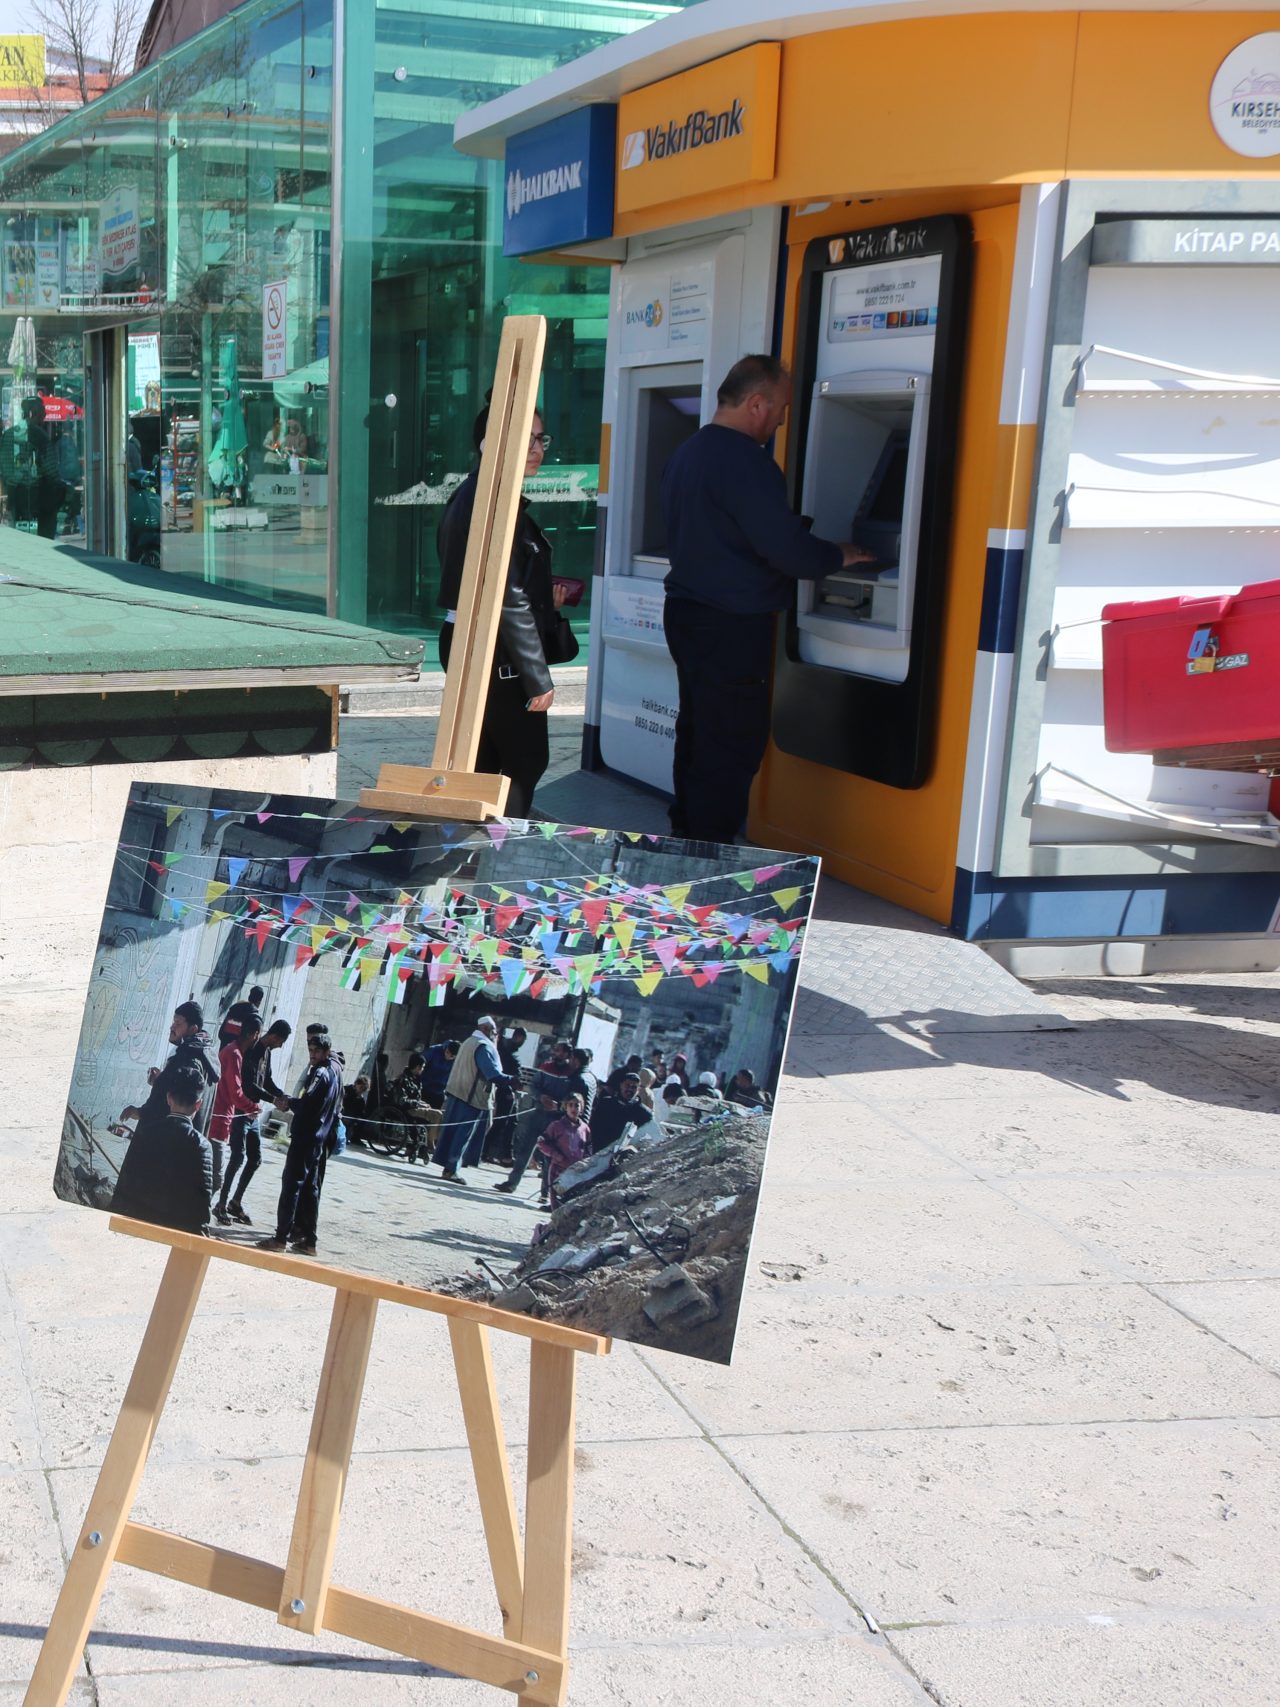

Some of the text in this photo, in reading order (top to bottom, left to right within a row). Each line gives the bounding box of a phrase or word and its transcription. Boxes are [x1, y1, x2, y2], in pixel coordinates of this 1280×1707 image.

[647, 98, 745, 162] VakıfBank
[521, 161, 583, 204] HALKBANK
[1173, 228, 1244, 252] KİTAP
